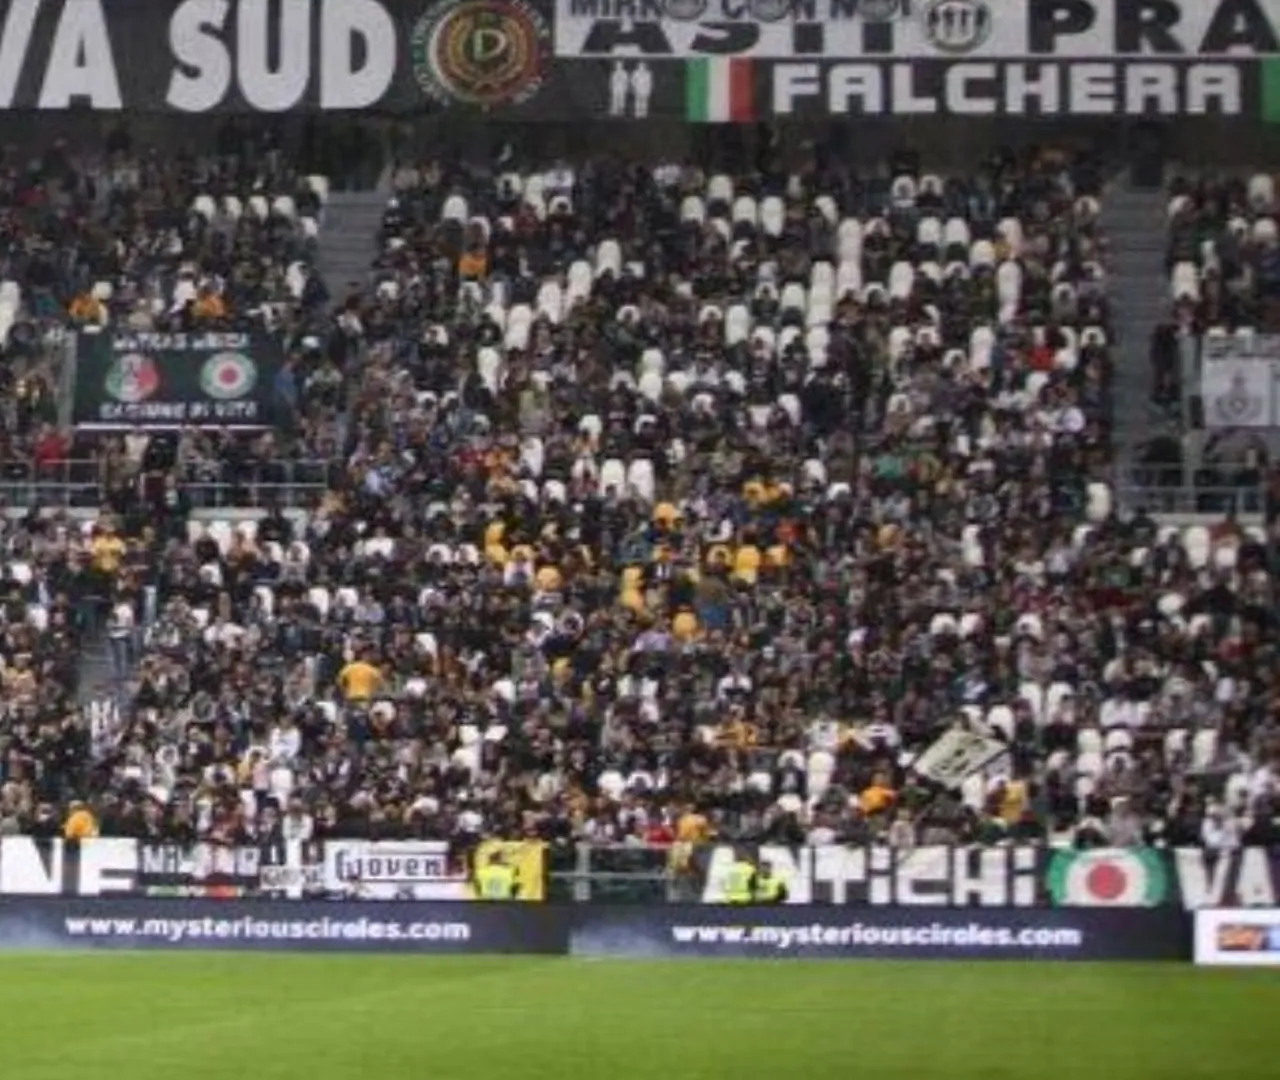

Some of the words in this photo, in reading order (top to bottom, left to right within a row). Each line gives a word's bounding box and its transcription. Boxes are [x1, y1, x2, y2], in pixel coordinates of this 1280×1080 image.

[772, 63, 1241, 114] FALCHERA
[63, 913, 472, 946] www.mysteriouscircles.com
[671, 922, 1081, 951] www.mysteriouscircles.com
